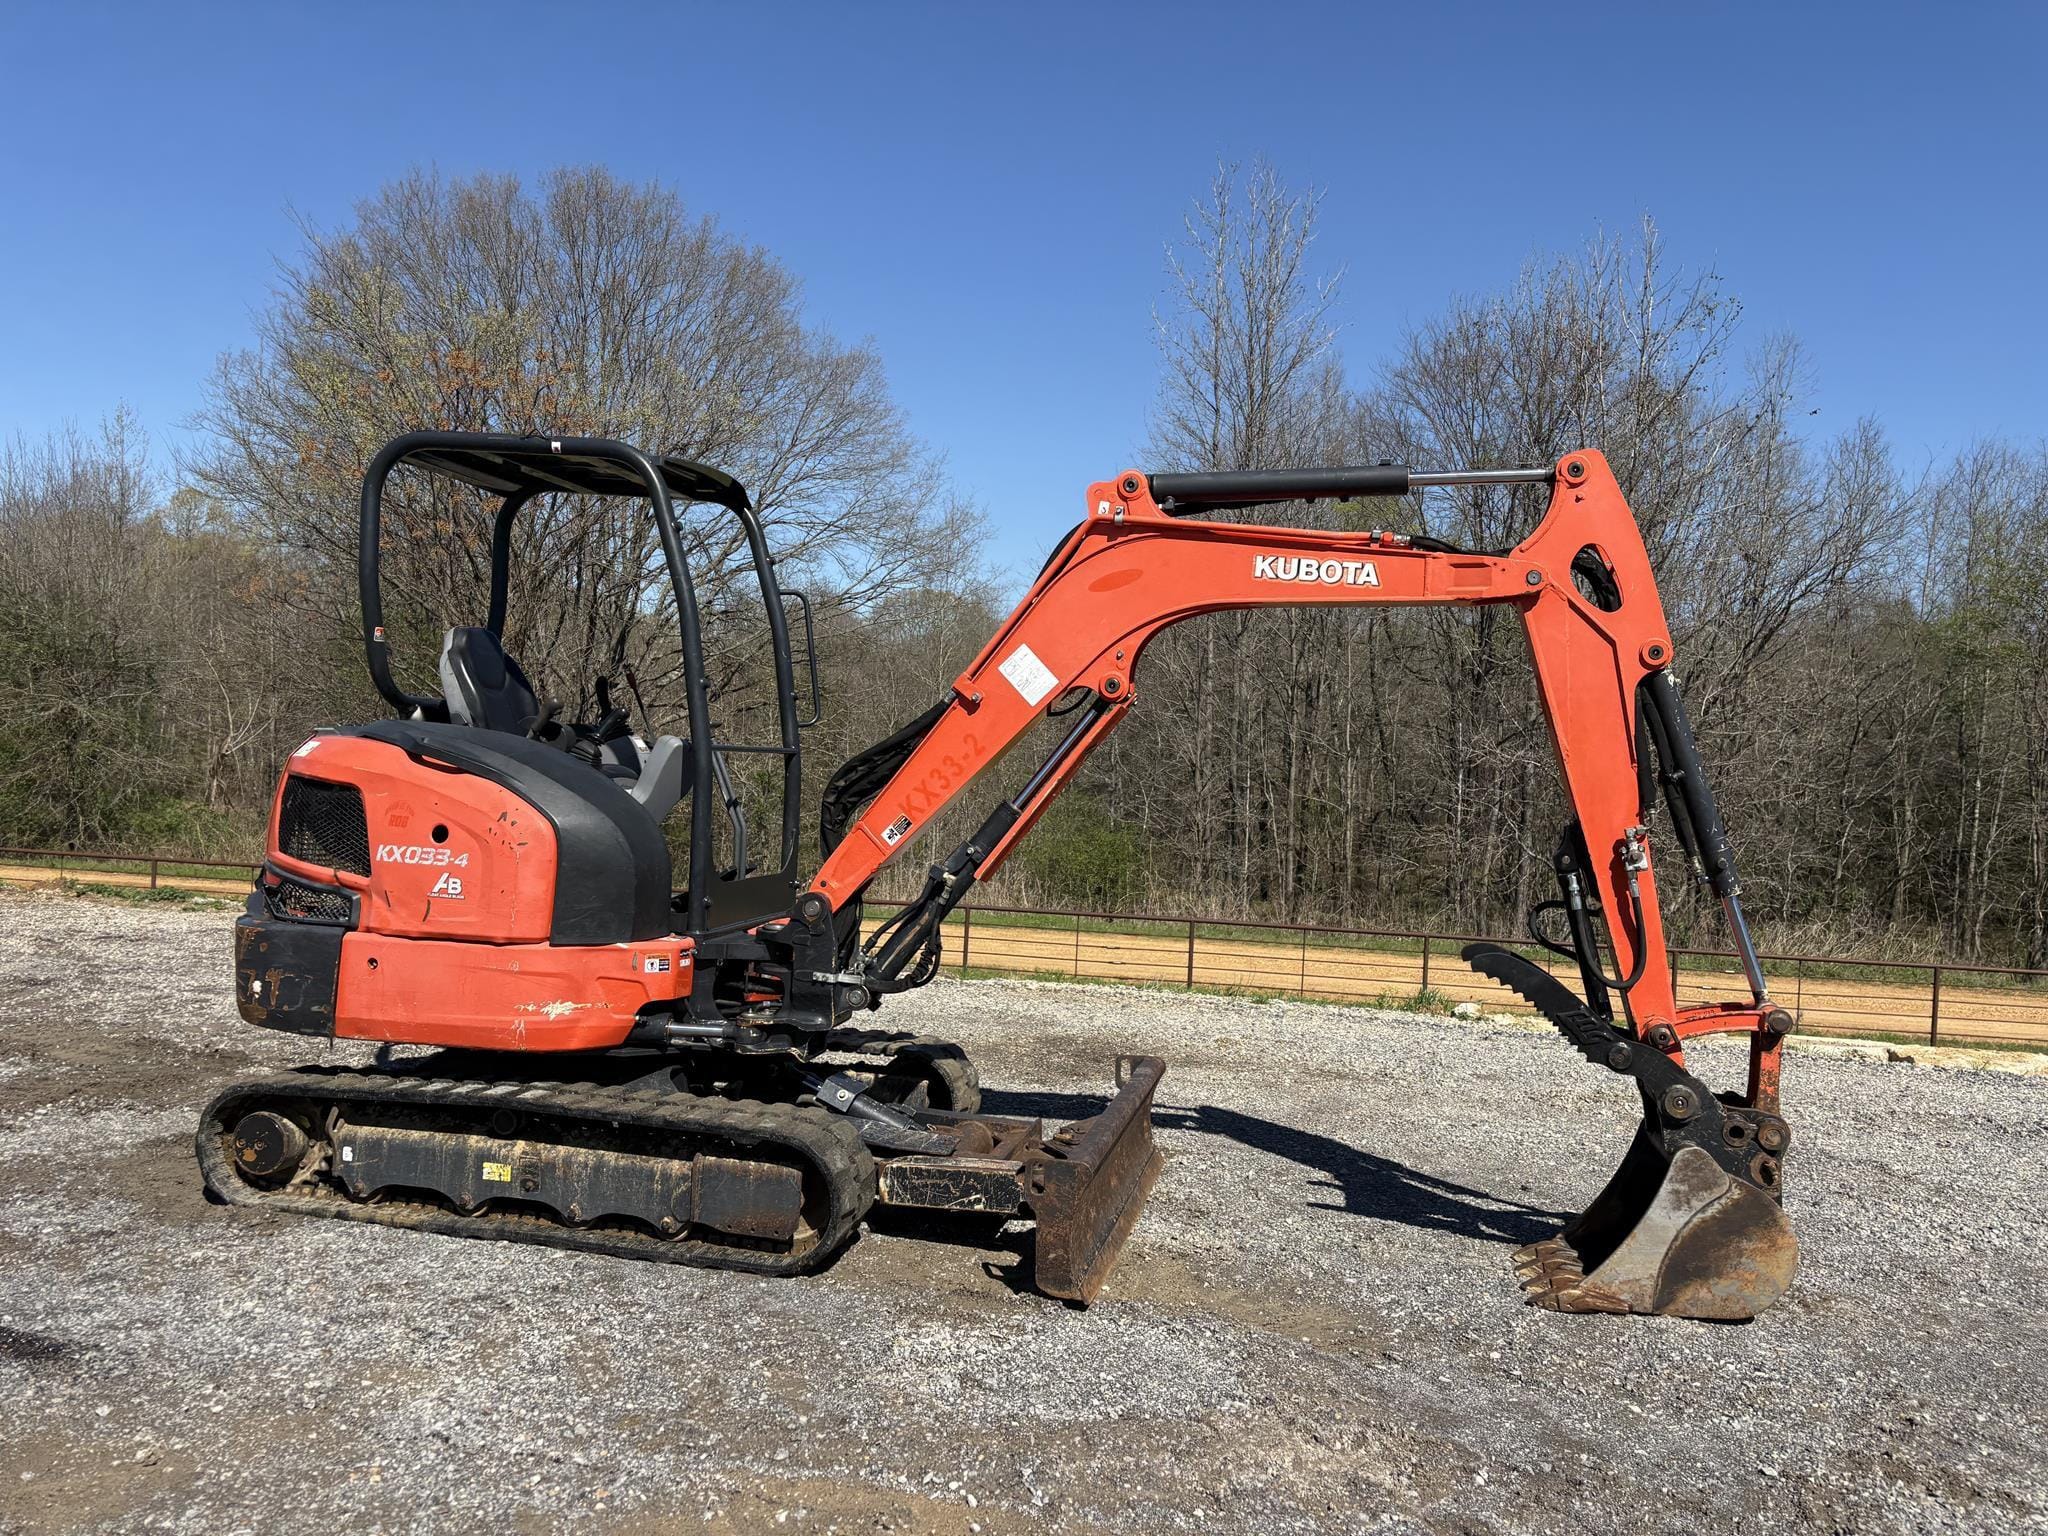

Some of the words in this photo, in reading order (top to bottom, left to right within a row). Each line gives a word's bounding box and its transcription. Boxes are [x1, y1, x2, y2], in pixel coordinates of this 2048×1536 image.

[1254, 555, 1380, 586] KUBOTA
[898, 733, 986, 817] KX33-2
[375, 844, 469, 867] KX033-4
